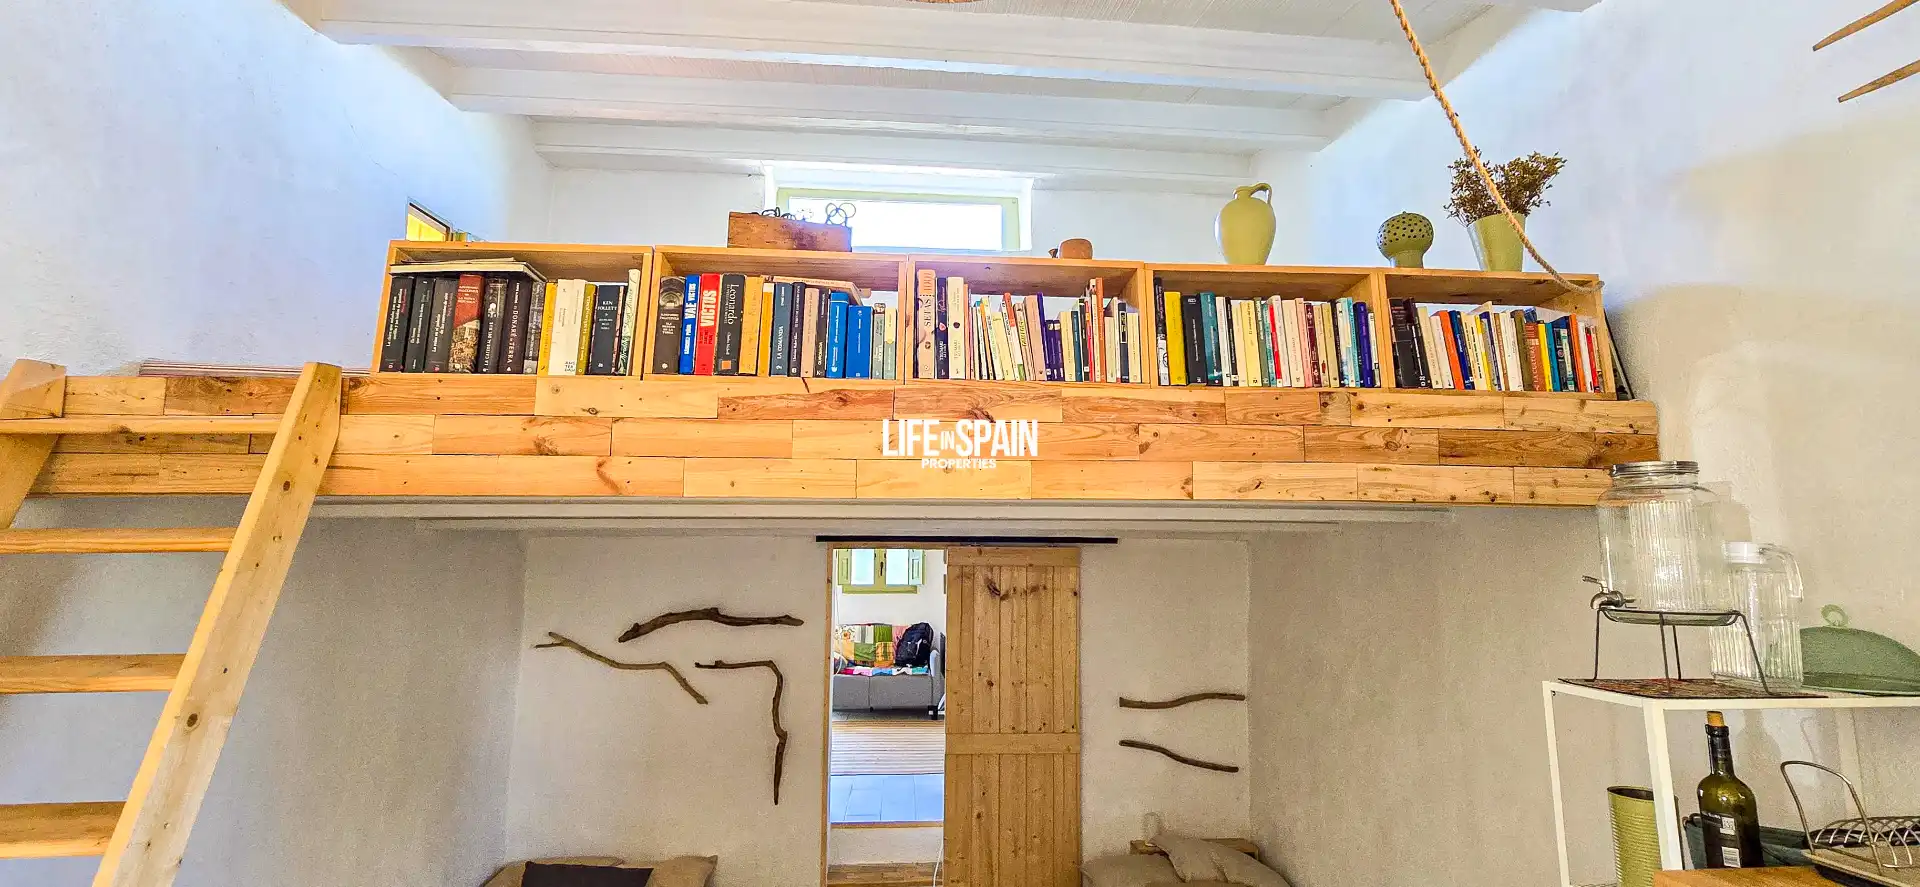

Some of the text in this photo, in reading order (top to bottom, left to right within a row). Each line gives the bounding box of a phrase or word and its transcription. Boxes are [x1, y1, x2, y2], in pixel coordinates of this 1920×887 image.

[684, 302, 697, 320] VAE
[700, 290, 716, 327] VICTUS
[728, 284, 739, 324] Leonardo
[510, 310, 519, 337] DONARÉ
[507, 342, 515, 364] TERRA
